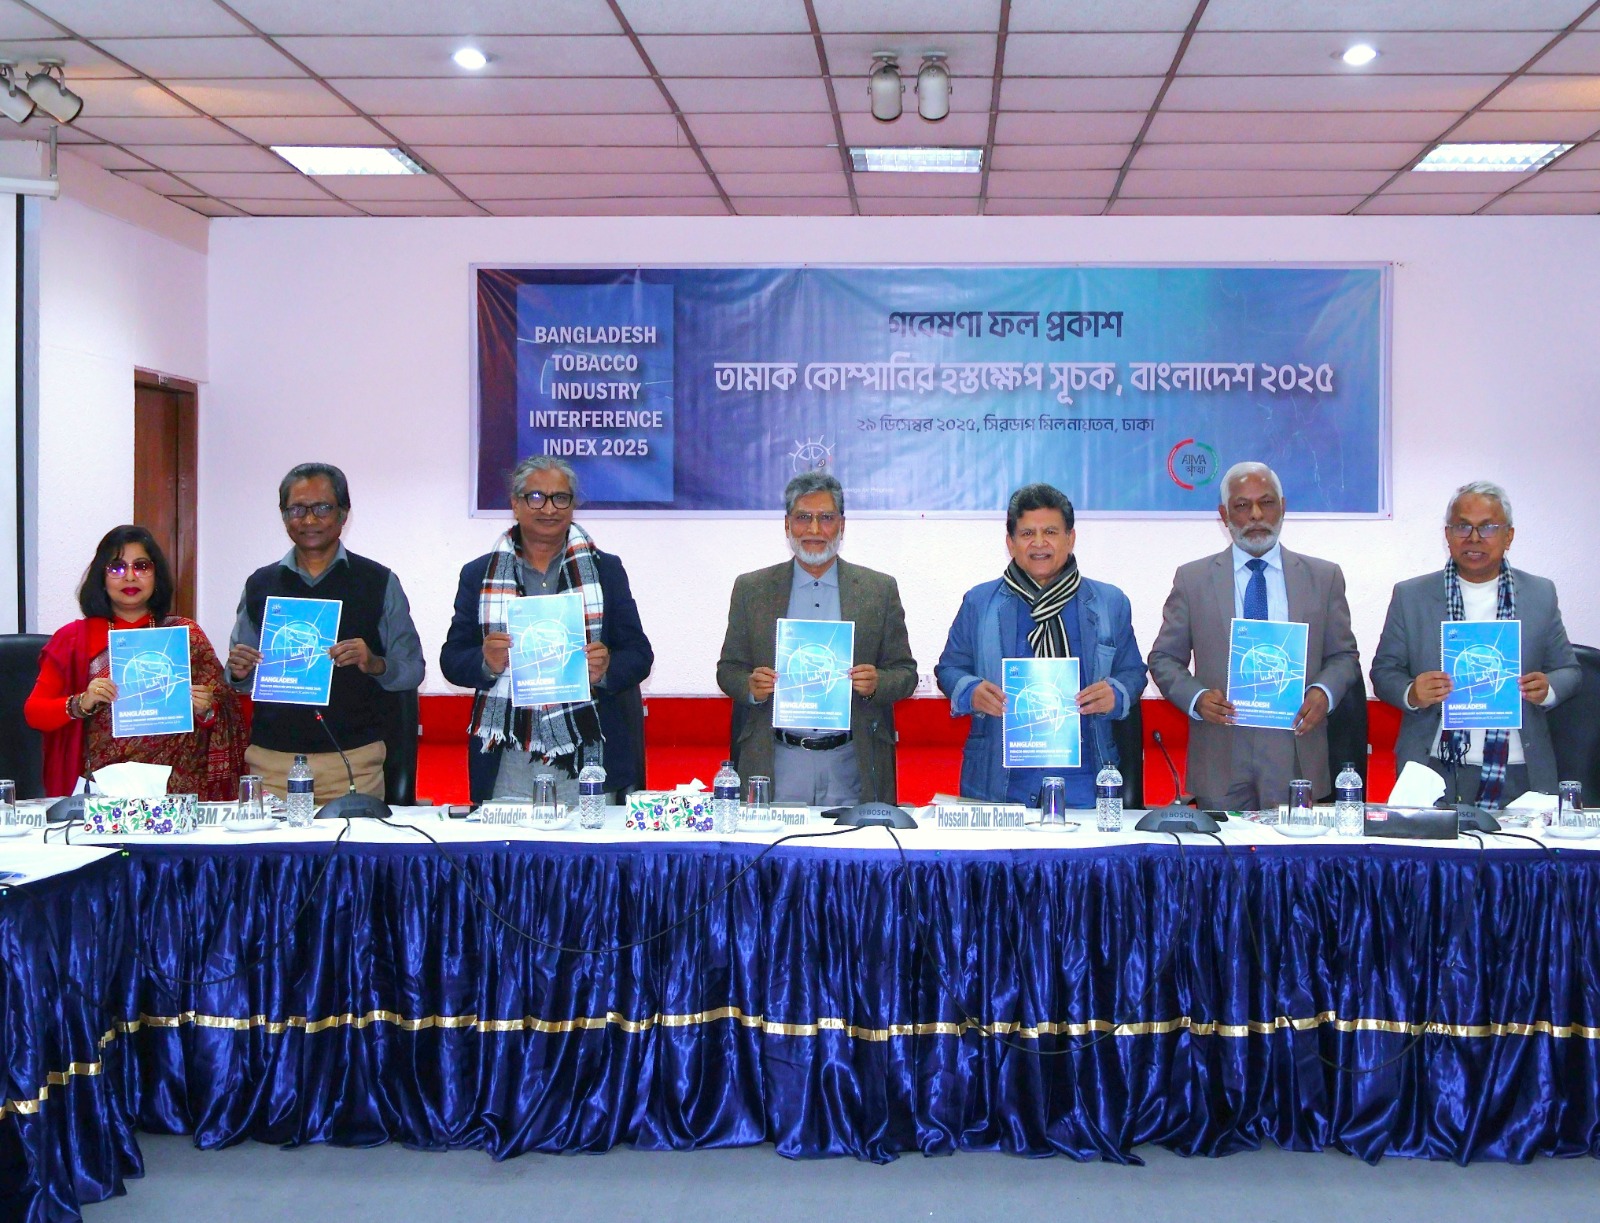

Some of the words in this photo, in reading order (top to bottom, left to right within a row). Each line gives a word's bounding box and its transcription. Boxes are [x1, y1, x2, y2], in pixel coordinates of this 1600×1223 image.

[535, 326, 657, 344] BANGLADESH
[888, 311, 983, 339] গবেষণা
[988, 311, 1040, 339] ফল
[1046, 311, 1124, 342] প্রকাশ
[552, 354, 638, 372] TOBACCO
[713, 362, 799, 391] তামাক
[804, 351, 936, 395] কোম্পানির
[940, 362, 1045, 395] হস্তক্ষেপ
[1049, 362, 1123, 405] সূচক,
[1129, 362, 1255, 392] বাংলাদেশ
[1260, 363, 1334, 393] ২০২৫
[551, 382, 642, 400] INDUSTRY
[529, 410, 663, 428] INTERFERENCE
[857, 418, 876, 431] ২৯
[880, 414, 933, 432] ডিসেম্বর
[937, 418, 980, 433] ২০২৫,
[984, 414, 1035, 432] সিরডাপ
[1039, 414, 1118, 433] মিলনায়তন,
[1122, 418, 1155, 431] ঢাকা
[543, 438, 597, 456] INDEX
[601, 438, 648, 456] 2025
[260, 676, 298, 684] BANGLADESH
[1232, 700, 1270, 708] BANGLADESH
[119, 709, 158, 718] BANGLADESH
[1009, 741, 1047, 749] BANGLADESH
[197, 807, 218, 825] BM
[482, 807, 528, 825] Saifuddin
[771, 809, 805, 826] Rahman
[937, 807, 969, 828] Hossain
[971, 807, 991, 828] Zillur
[993, 807, 1025, 829] Rahman
